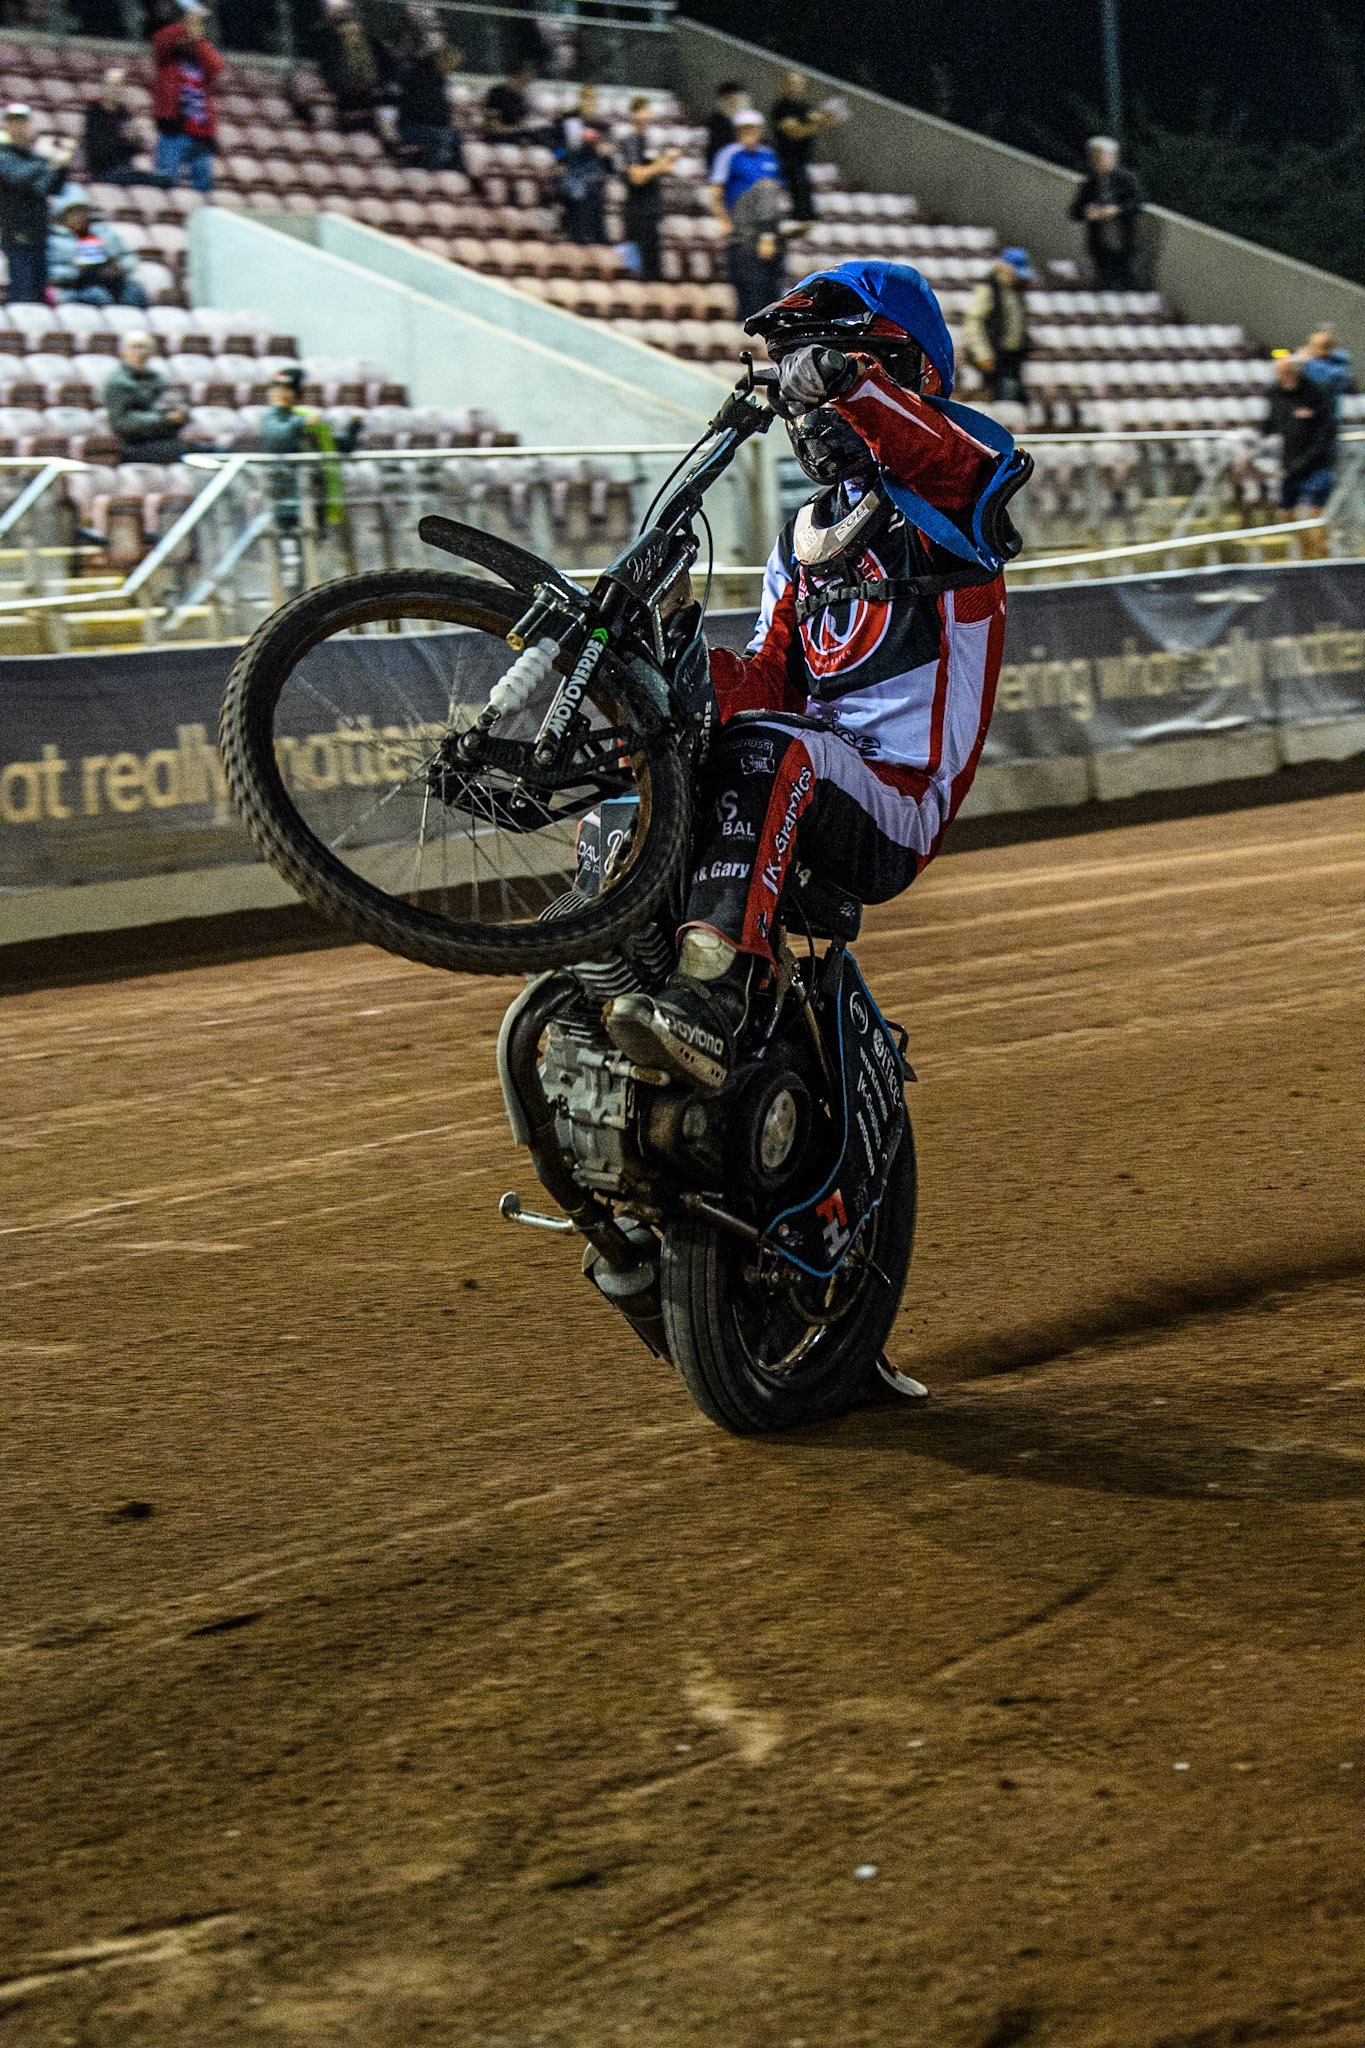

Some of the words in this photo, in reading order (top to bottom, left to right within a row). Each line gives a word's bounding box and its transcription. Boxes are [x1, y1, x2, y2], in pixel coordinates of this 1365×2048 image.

[548, 639, 604, 739] MOTOVERDE
[721, 821, 756, 836] BAL
[710, 861, 751, 879] Gary
